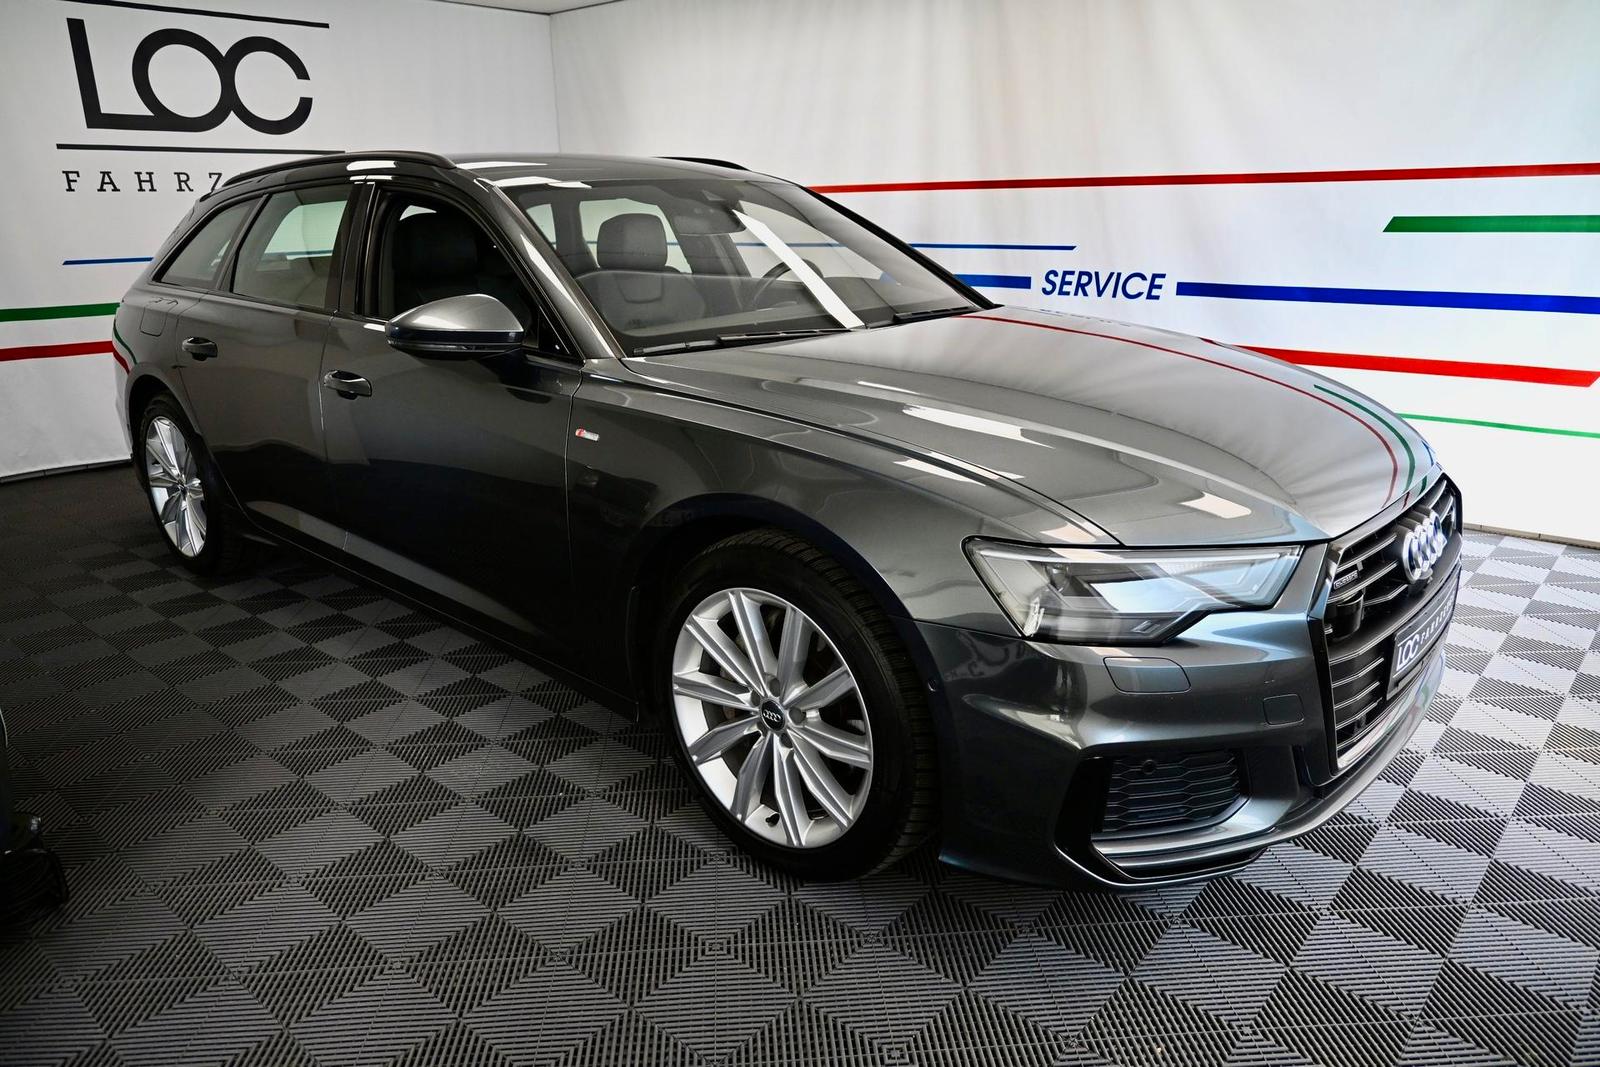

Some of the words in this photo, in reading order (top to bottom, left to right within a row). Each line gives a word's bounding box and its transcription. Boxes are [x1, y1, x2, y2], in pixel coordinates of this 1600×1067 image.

[66, 17, 313, 136] LOC
[62, 170, 223, 193] FAHRZ
[1041, 269, 1167, 301] SERVICE
[1396, 634, 1420, 672] LOC
